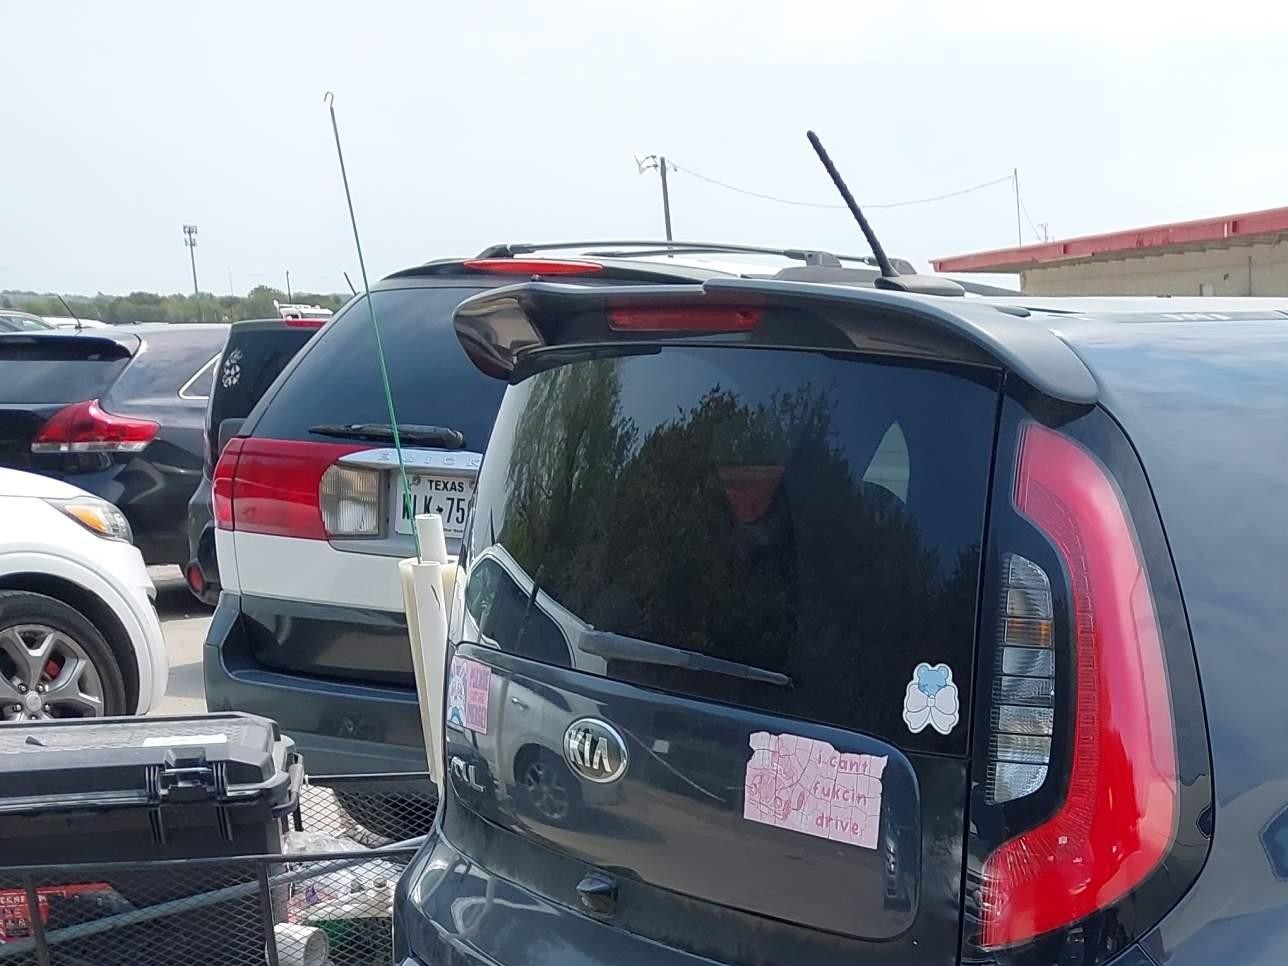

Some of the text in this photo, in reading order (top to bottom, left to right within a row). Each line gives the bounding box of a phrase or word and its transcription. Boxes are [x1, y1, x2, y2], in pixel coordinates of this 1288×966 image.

[427, 479, 465, 493] TEXAS
[813, 781, 868, 807] fukcin
[815, 812, 859, 836] drive
